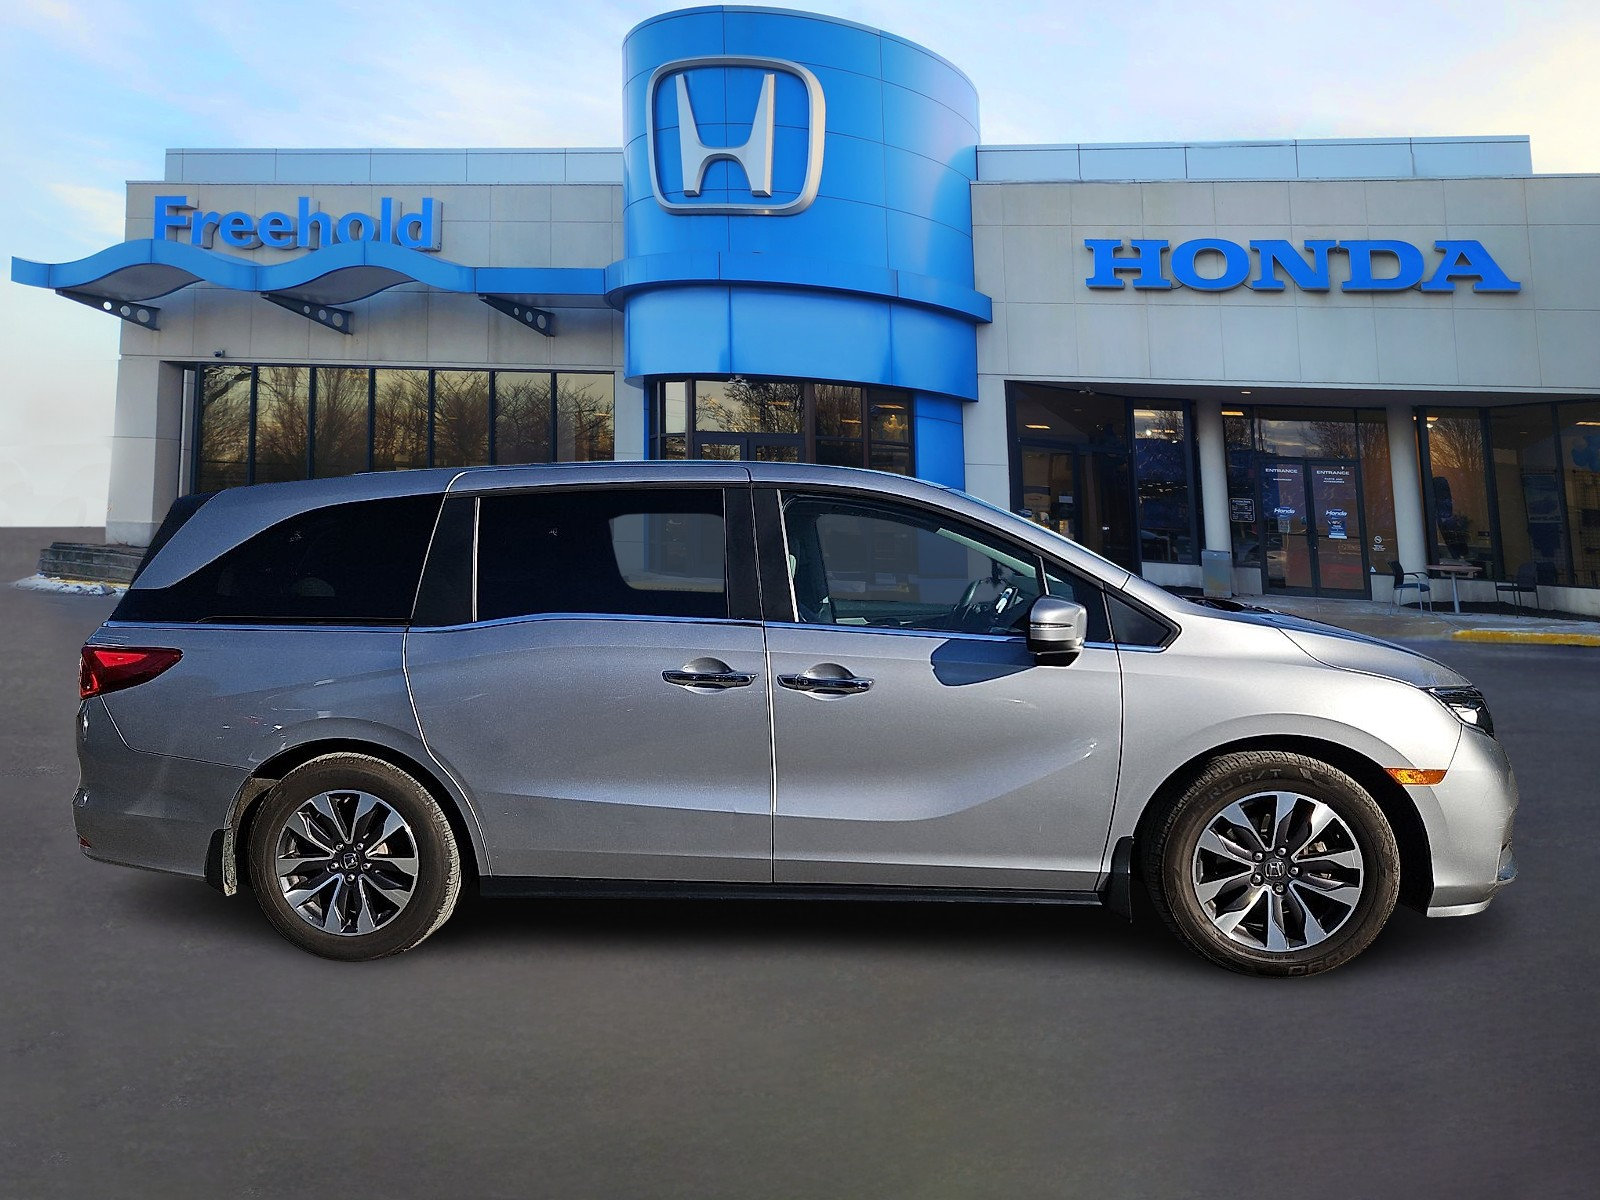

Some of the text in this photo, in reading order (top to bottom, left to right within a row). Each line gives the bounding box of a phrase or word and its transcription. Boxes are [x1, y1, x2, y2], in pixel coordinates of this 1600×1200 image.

[154, 195, 437, 249] Freehold
[1084, 238, 1521, 292] HONDA
[1273, 507, 1296, 515] Honda
